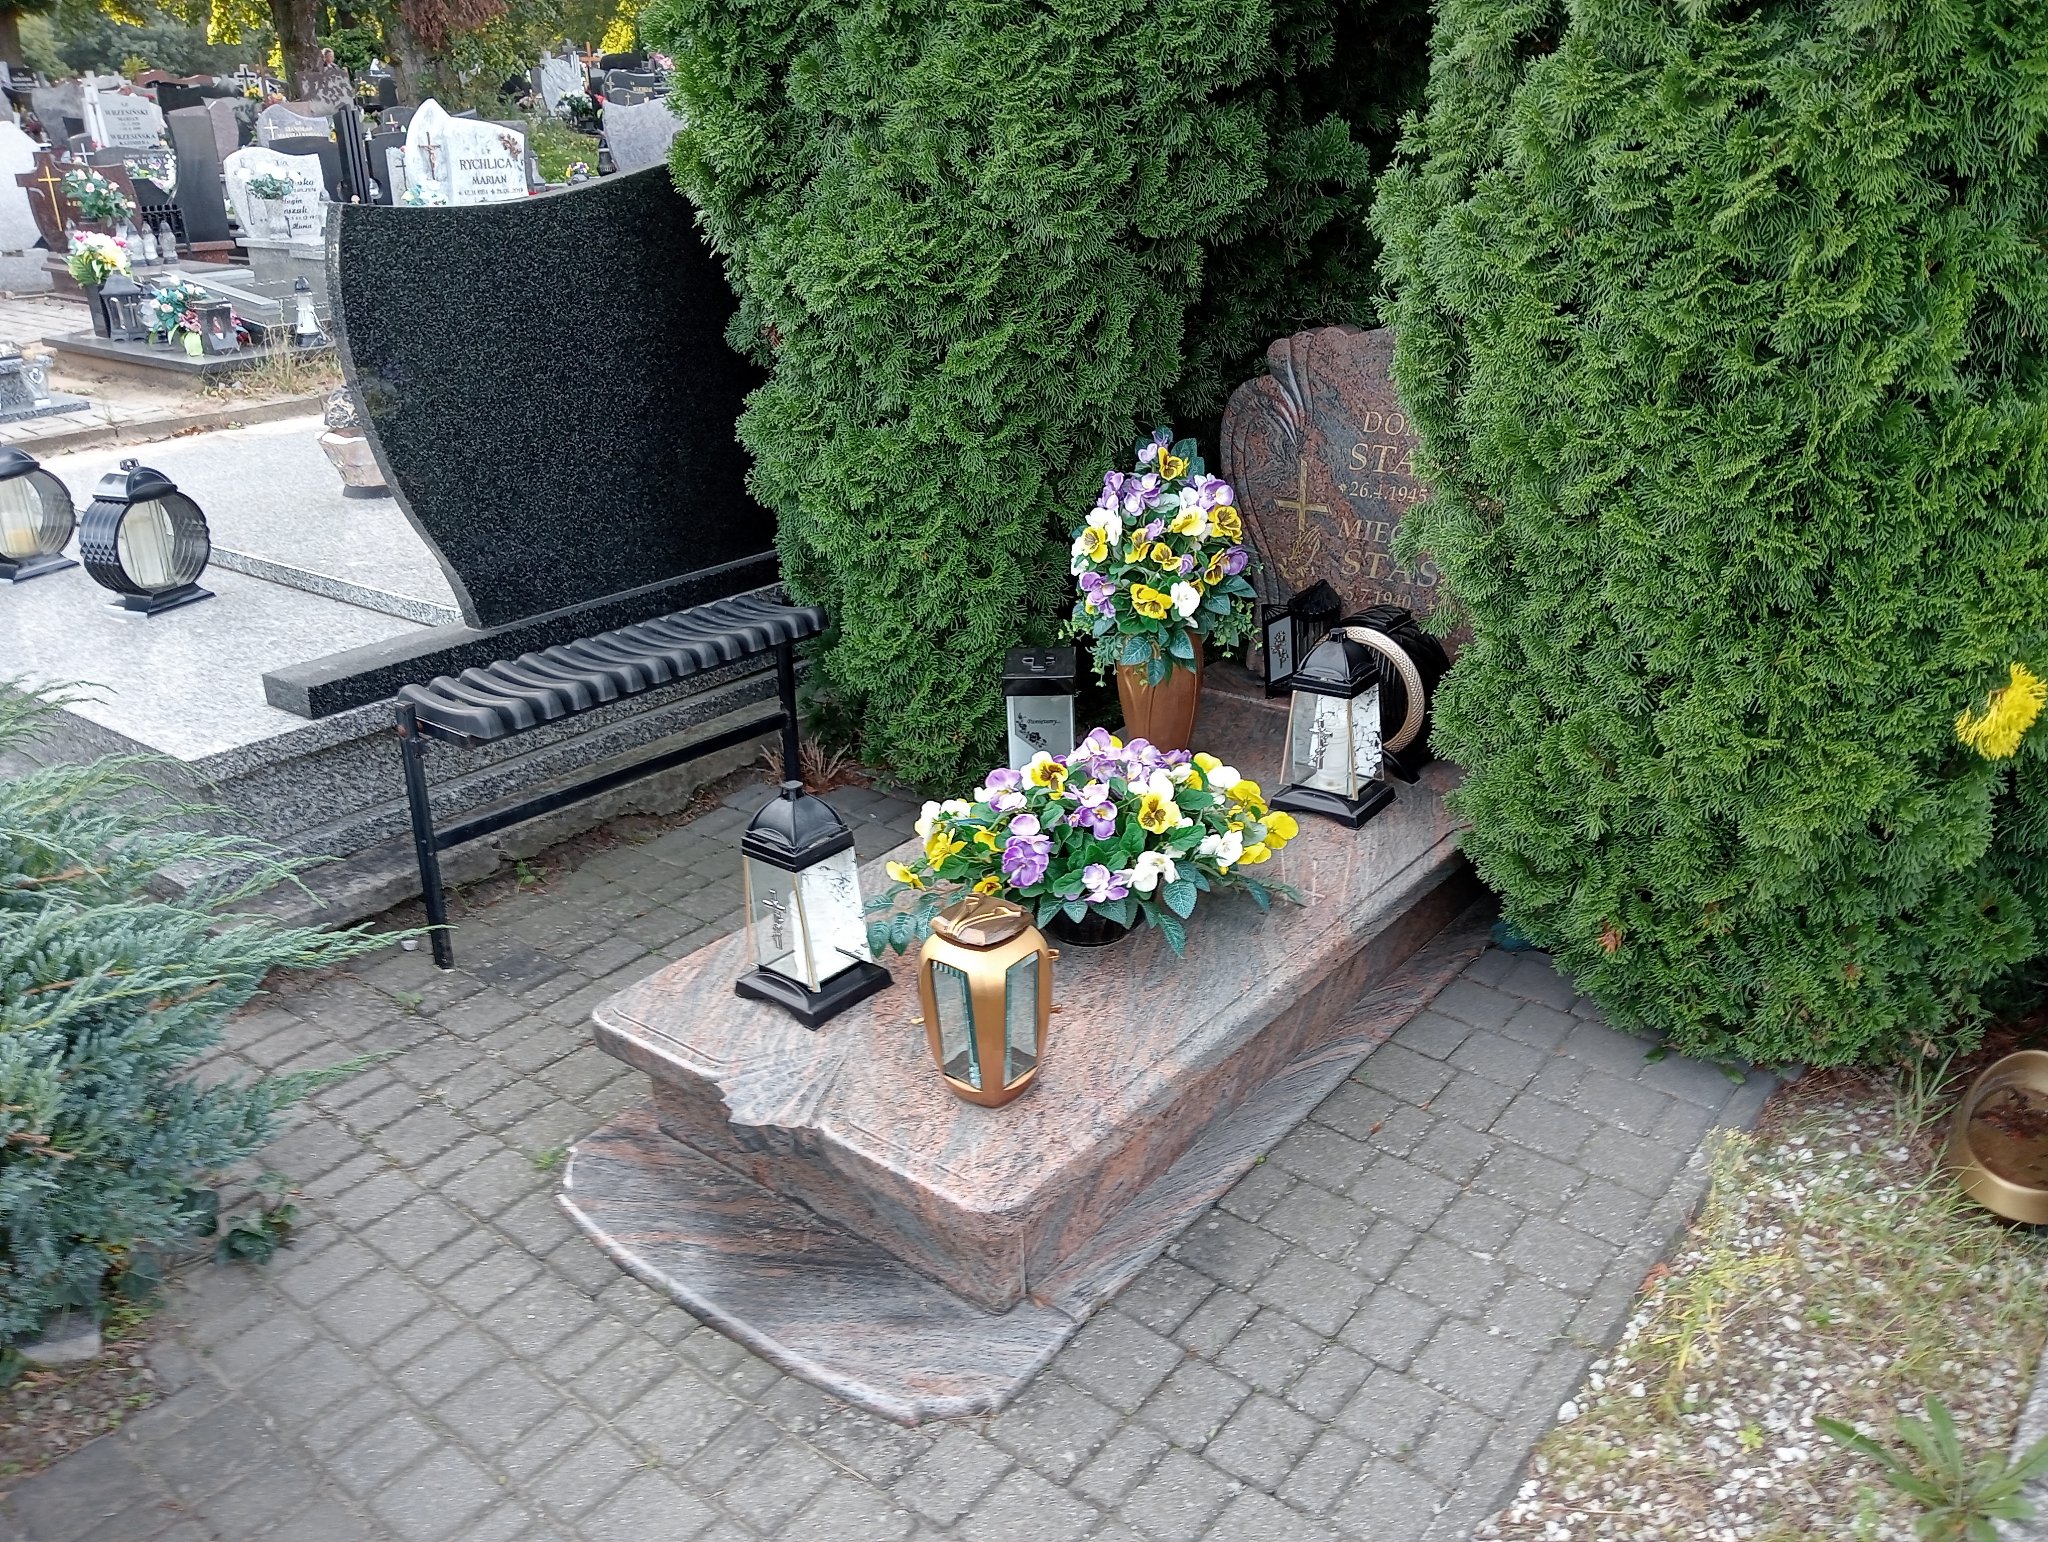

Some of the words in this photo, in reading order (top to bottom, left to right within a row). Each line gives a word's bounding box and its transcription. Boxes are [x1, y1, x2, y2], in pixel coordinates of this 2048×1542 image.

[460, 158, 512, 170] RYCHLICA
[472, 174, 507, 185] MARIAN
[1348, 442, 1414, 477] STA
[1341, 549, 1438, 588] STAS
